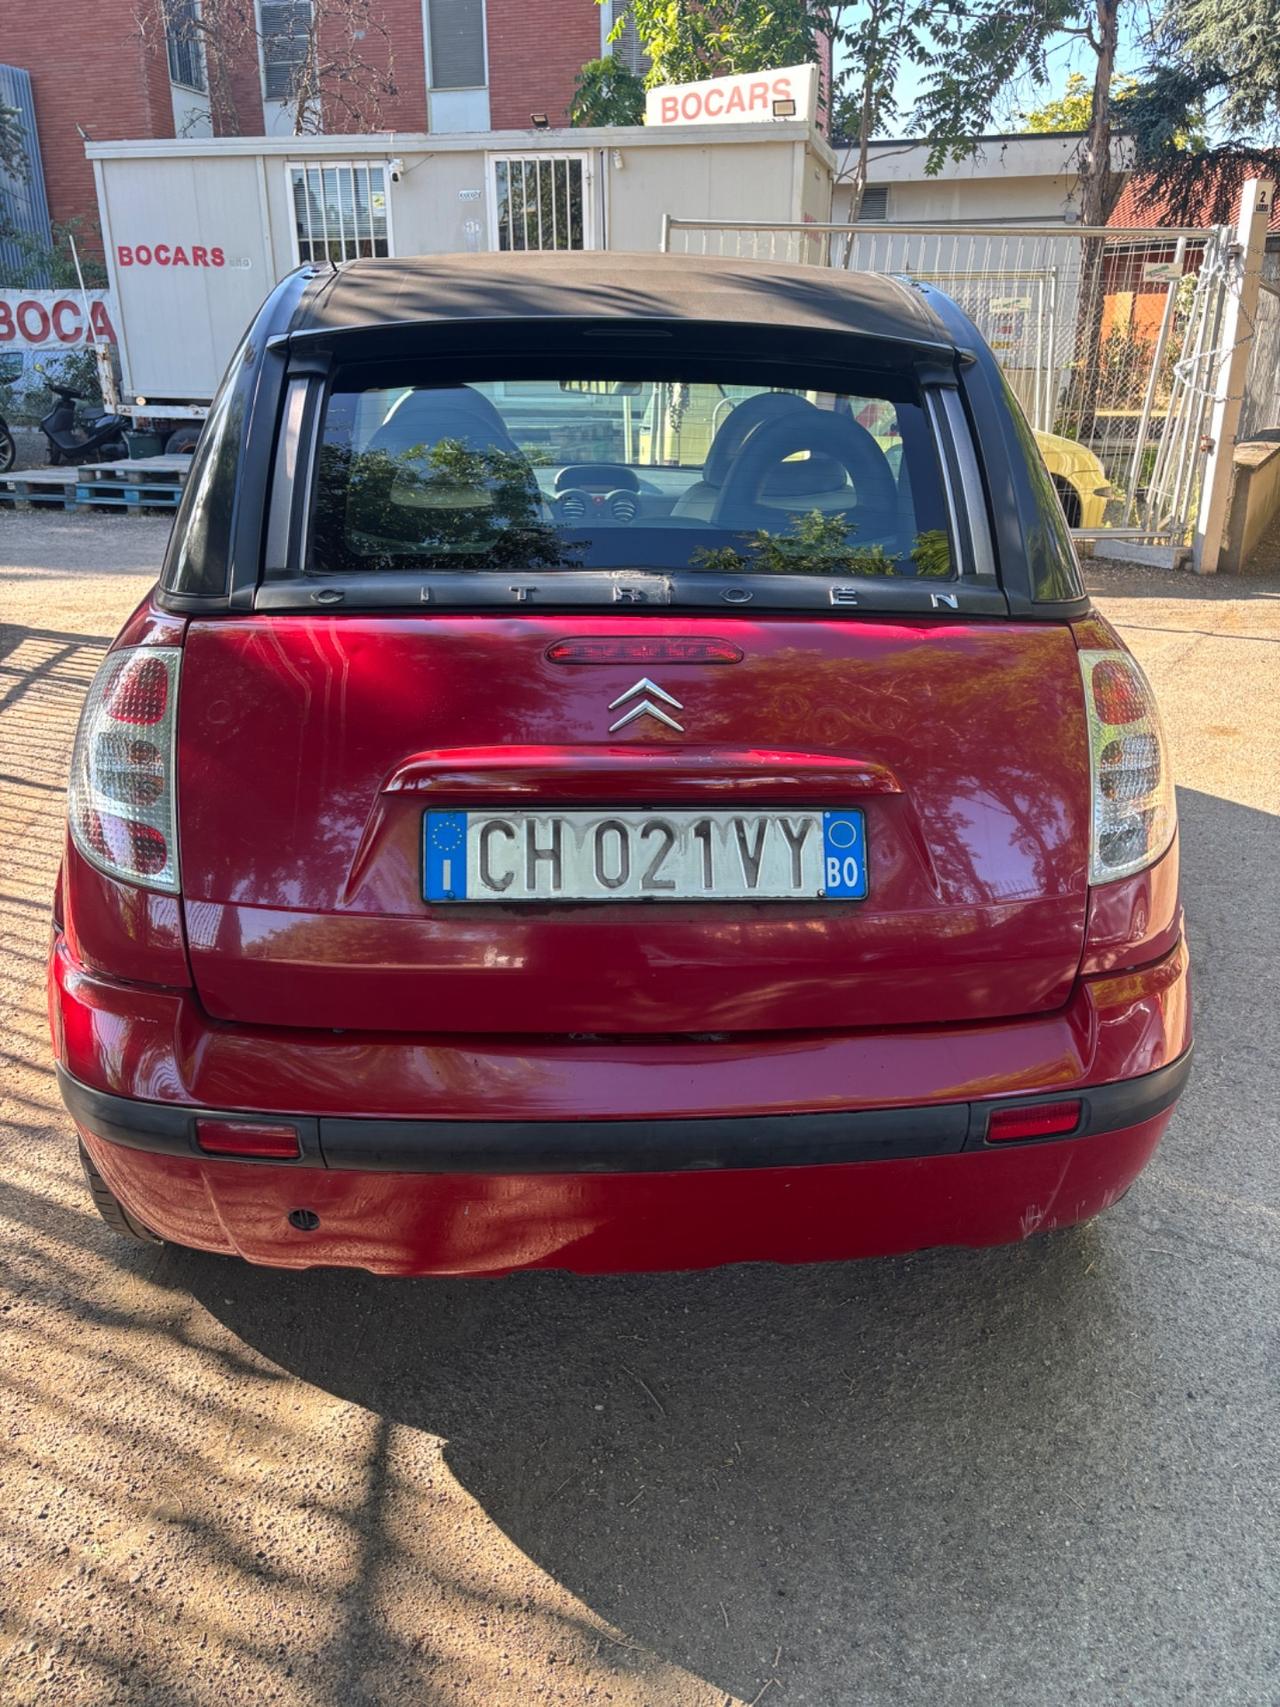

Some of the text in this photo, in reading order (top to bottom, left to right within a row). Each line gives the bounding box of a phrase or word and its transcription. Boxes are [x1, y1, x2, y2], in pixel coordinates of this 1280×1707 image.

[661, 78, 791, 123] BOCARS
[1259, 190, 1267, 203] 2
[117, 244, 225, 267] BOCARS
[827, 856, 858, 888] BO
